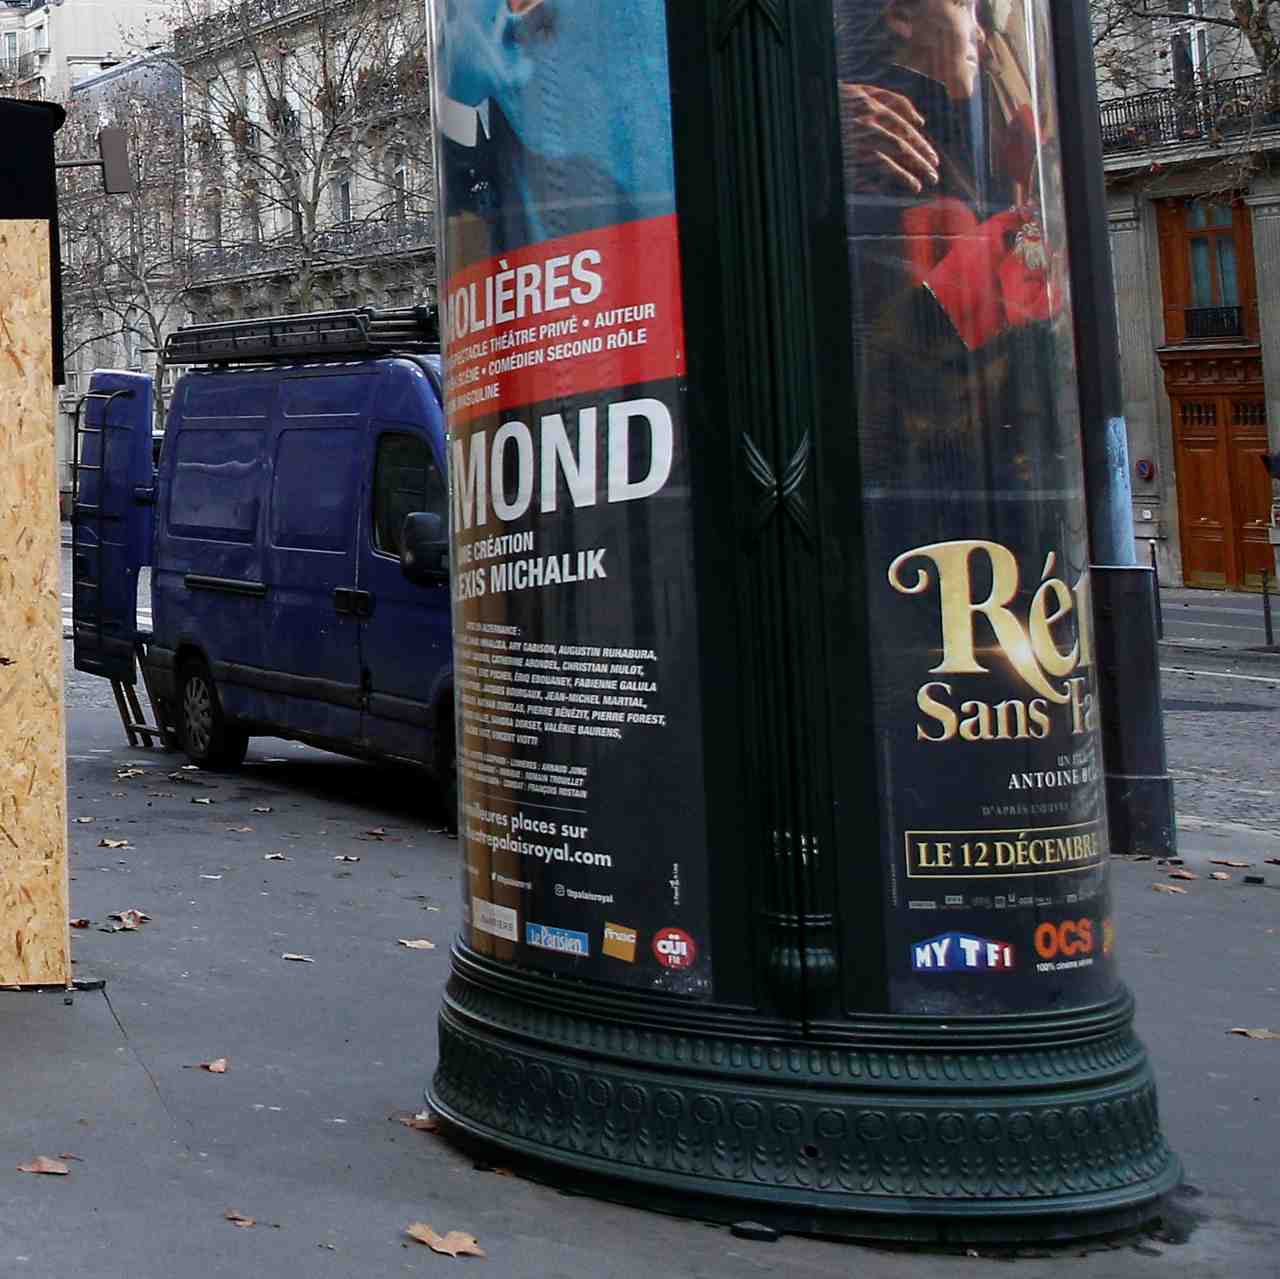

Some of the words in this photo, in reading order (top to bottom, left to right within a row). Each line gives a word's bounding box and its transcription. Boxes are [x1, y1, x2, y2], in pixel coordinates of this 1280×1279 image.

[490, 326, 537, 354] THÉÂTRE
[539, 313, 578, 340] PRIVÉ
[594, 302, 656, 329] AUTEUR
[488, 345, 544, 377] COMÉDIEN
[546, 335, 603, 363] SECOND
[606, 327, 648, 352] RÔLE
[453, 398, 674, 534] MOND
[473, 531, 534, 561] CRÉATION
[456, 568, 486, 601] EXIS
[490, 548, 608, 594] MICHALIK
[916, 682, 1051, 742] Sans
[1007, 768, 1079, 790] ANTOINE
[511, 812, 557, 835] places
[561, 824, 588, 839] sur
[916, 841, 952, 868] LE
[960, 841, 990, 867] 12
[993, 831, 1098, 867] DÉCEMBRE
[1033, 917, 1095, 961] OCS
